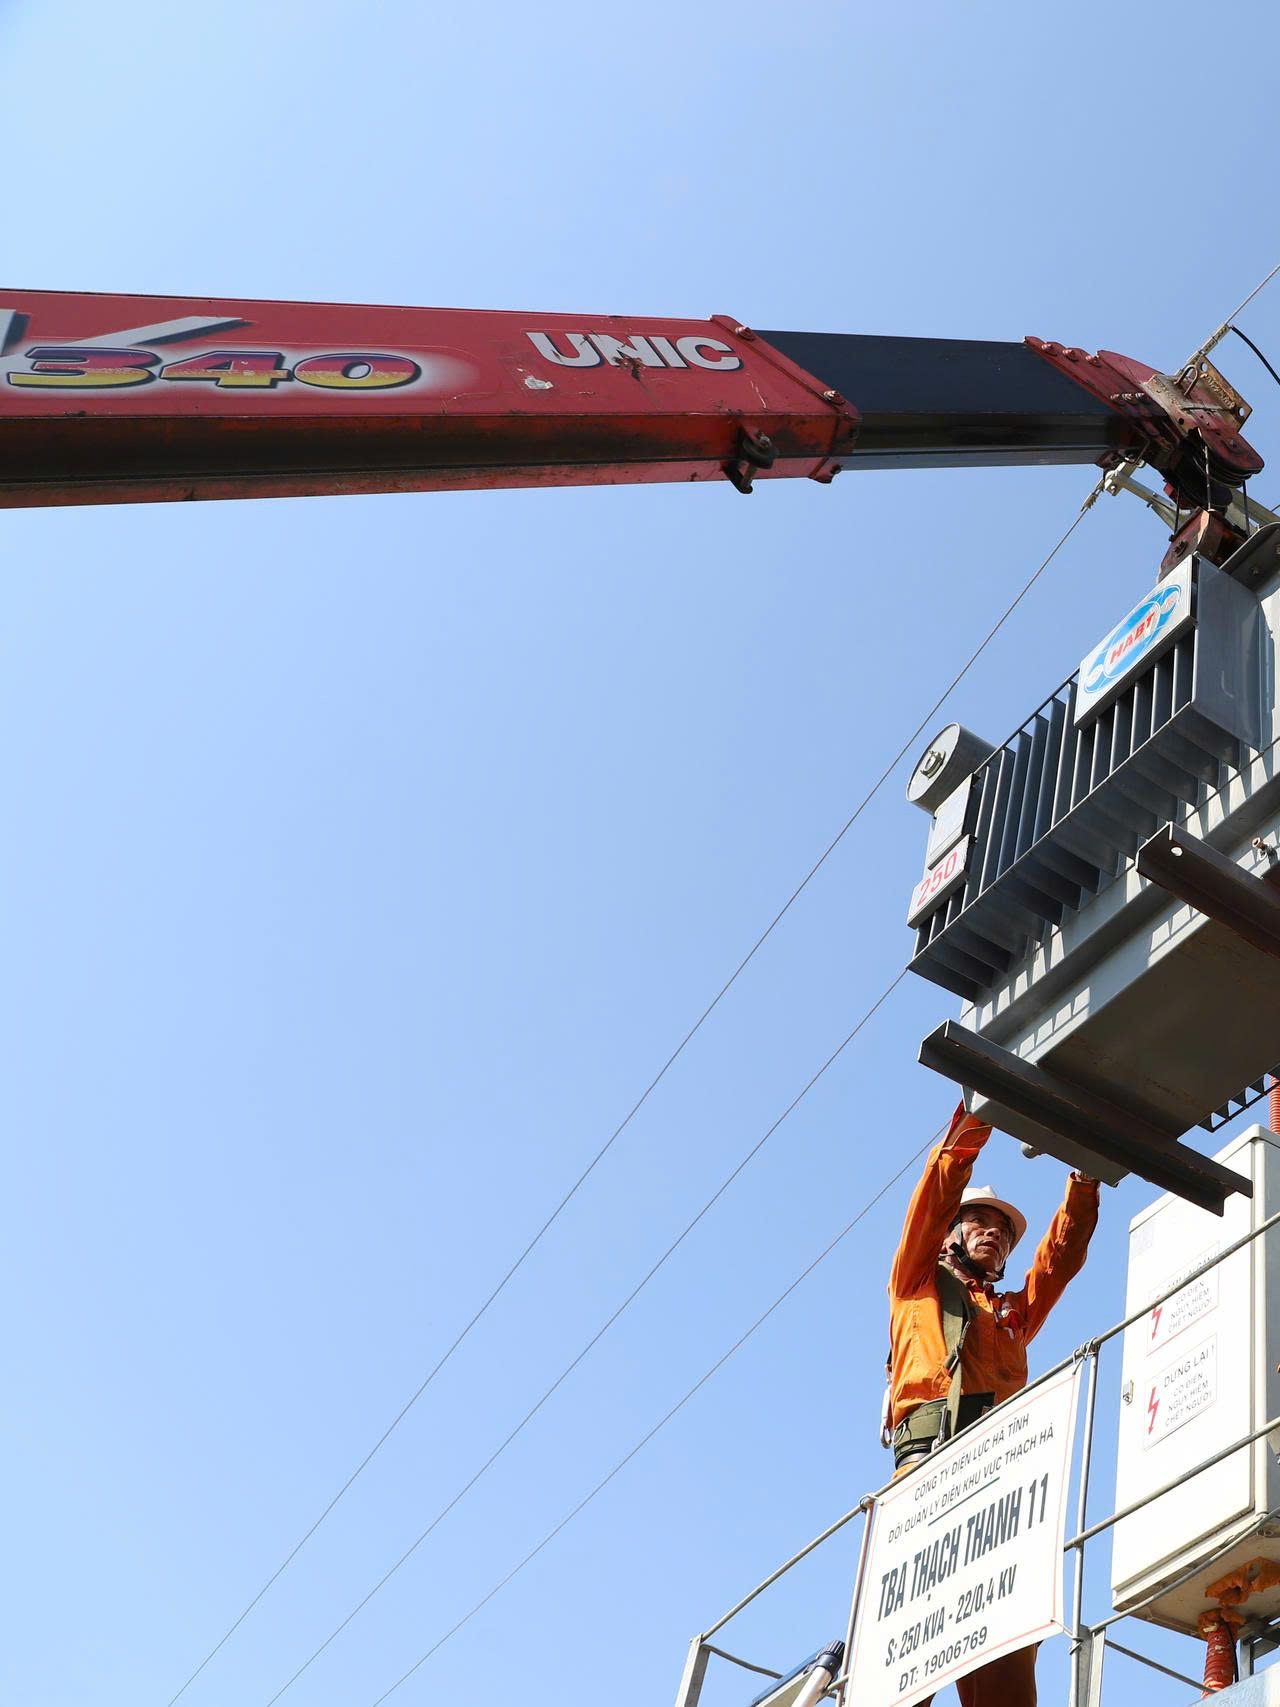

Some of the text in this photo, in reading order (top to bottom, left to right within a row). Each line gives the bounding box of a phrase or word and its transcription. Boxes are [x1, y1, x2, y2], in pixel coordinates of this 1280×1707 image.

[8, 346, 421, 390] 340
[526, 331, 744, 371] UNIC
[1110, 611, 1156, 664] HABT
[916, 850, 958, 906] 250
[914, 1476, 938, 1501] CÔNG
[940, 1466, 950, 1484] TY
[952, 1454, 972, 1476] ĐIỆN
[992, 1428, 1005, 1447] HÀ
[941, 1484, 961, 1507] ĐIỆN
[963, 1471, 981, 1492] KHU
[1005, 1436, 1037, 1464] THẠCH
[878, 1473, 1049, 1622] TBA THẠCH THANH 11
[885, 1637, 898, 1667] S:
[899, 1622, 921, 1659] 250
[922, 1606, 946, 1645] KVA
[955, 1577, 994, 1624] 22/0,4
[998, 1564, 1017, 1600] KV
[898, 1626, 988, 1692] ĐT: 19006769
